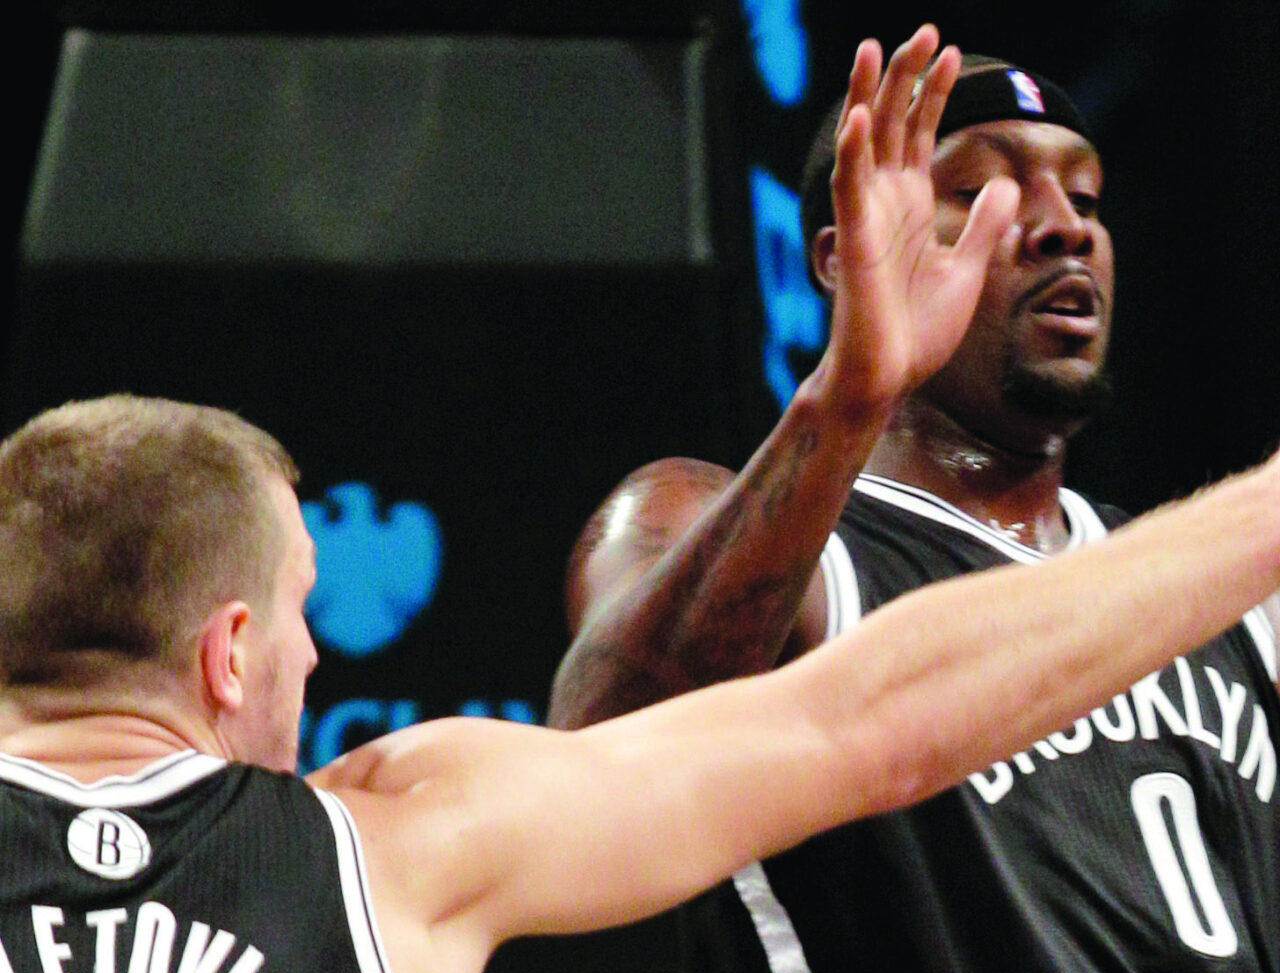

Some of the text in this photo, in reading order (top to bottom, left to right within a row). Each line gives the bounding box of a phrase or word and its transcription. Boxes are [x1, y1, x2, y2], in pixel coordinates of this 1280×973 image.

[968, 657, 1278, 804] OKLYN
[96, 820, 121, 866] B
[1131, 771, 1238, 958] 0
